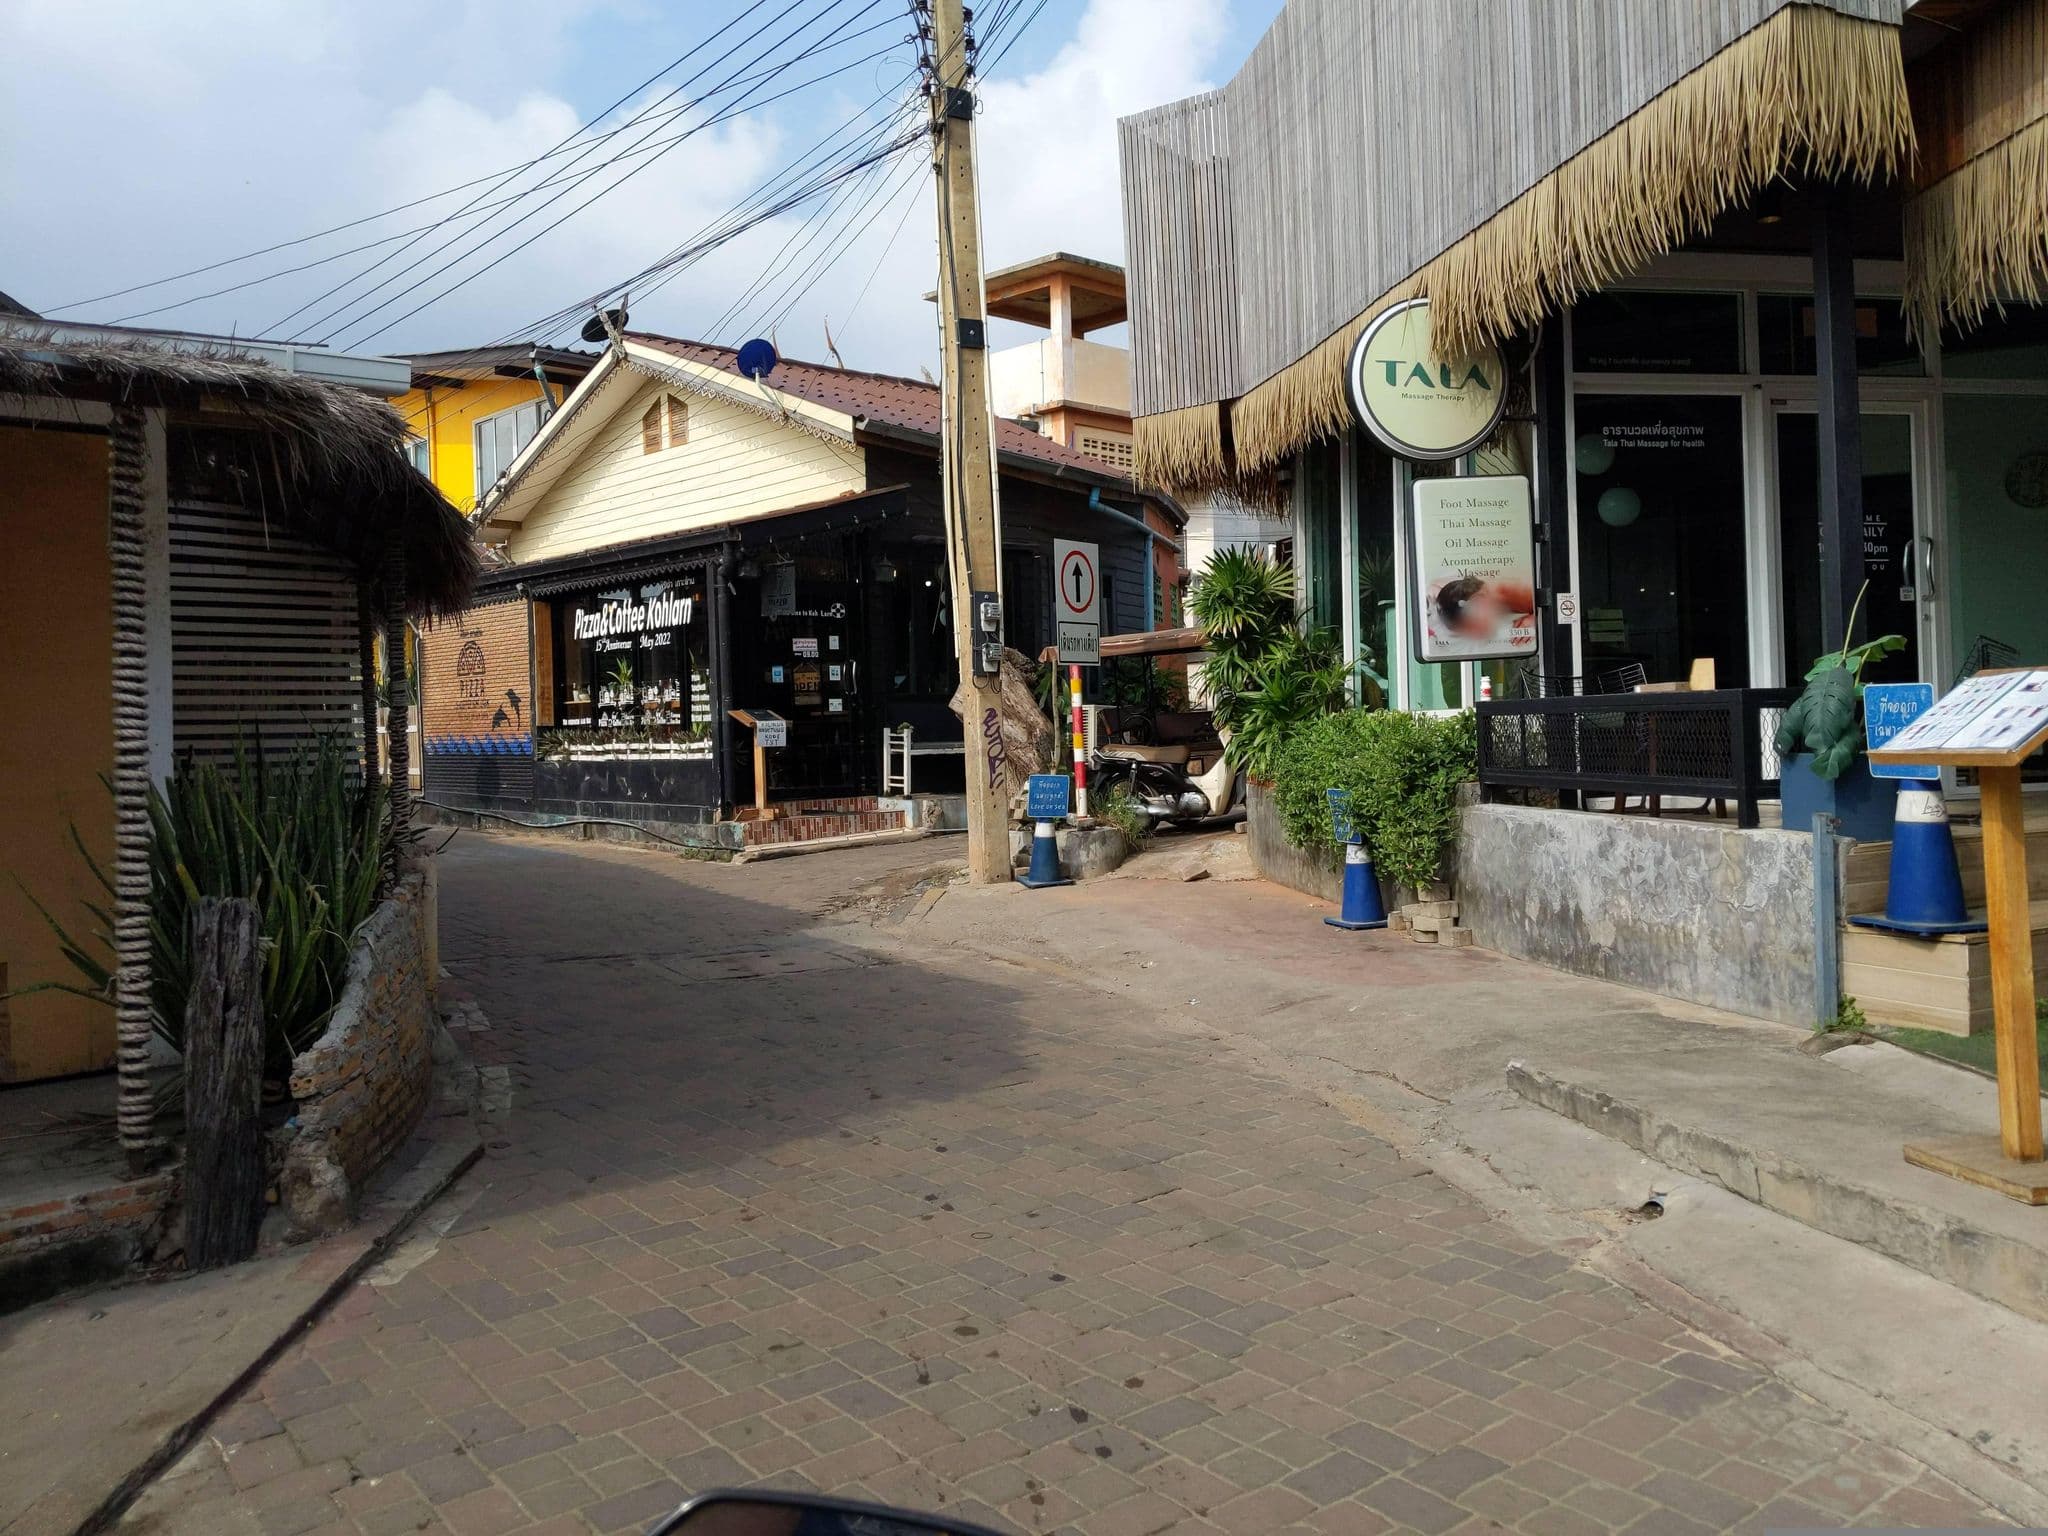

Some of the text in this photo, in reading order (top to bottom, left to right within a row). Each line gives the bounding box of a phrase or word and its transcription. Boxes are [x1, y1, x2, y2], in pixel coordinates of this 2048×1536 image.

[1374, 359, 1491, 391] TALA
[1401, 392, 1466, 402] Massage Therapy
[1670, 439, 1681, 447] for
[1682, 439, 1705, 447] health
[1439, 496, 1509, 509] Foot Massage
[1439, 518, 1512, 529] Thai Massage
[1444, 537, 1509, 549] Oil Massage
[1441, 554, 1515, 567] Aromatherapy
[1457, 566, 1500, 579] Massage
[646, 590, 692, 630] Kohlarn
[654, 631, 671, 646] 2022
